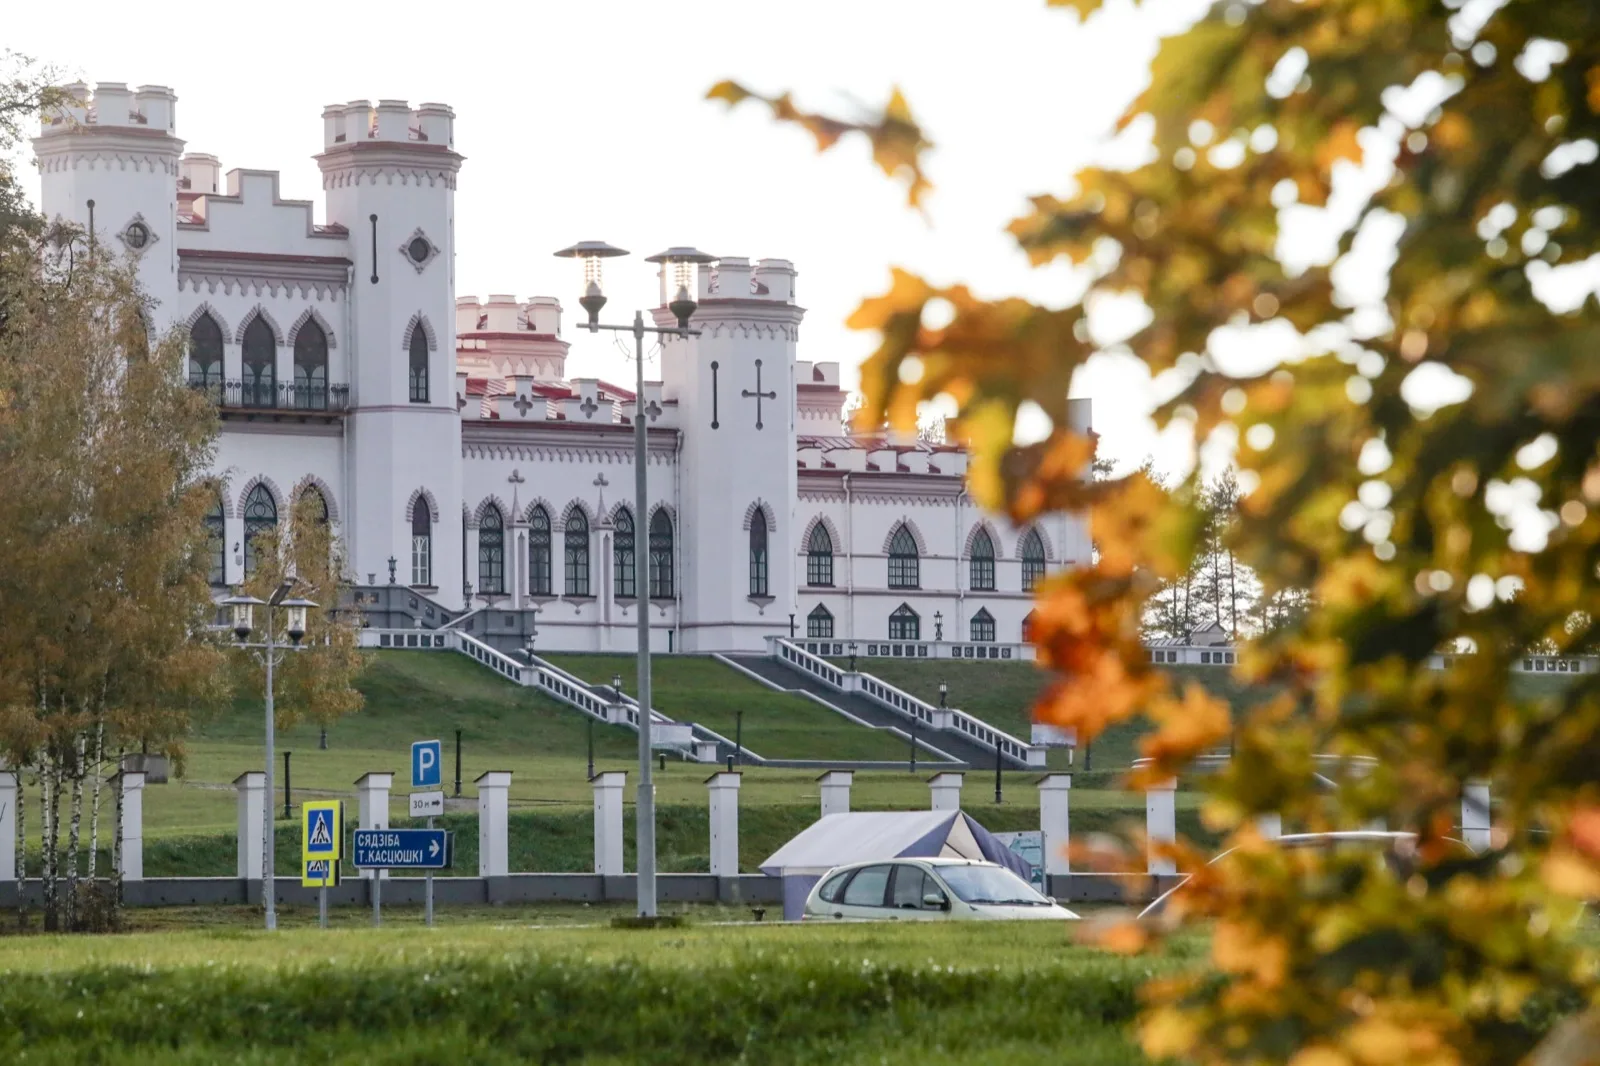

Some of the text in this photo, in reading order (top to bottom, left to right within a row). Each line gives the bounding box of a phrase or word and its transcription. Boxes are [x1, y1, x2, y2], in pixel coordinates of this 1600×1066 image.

[419, 748, 434, 781] P
[413, 800, 423, 809] 30
[358, 834, 400, 848] СЯДЗІБА
